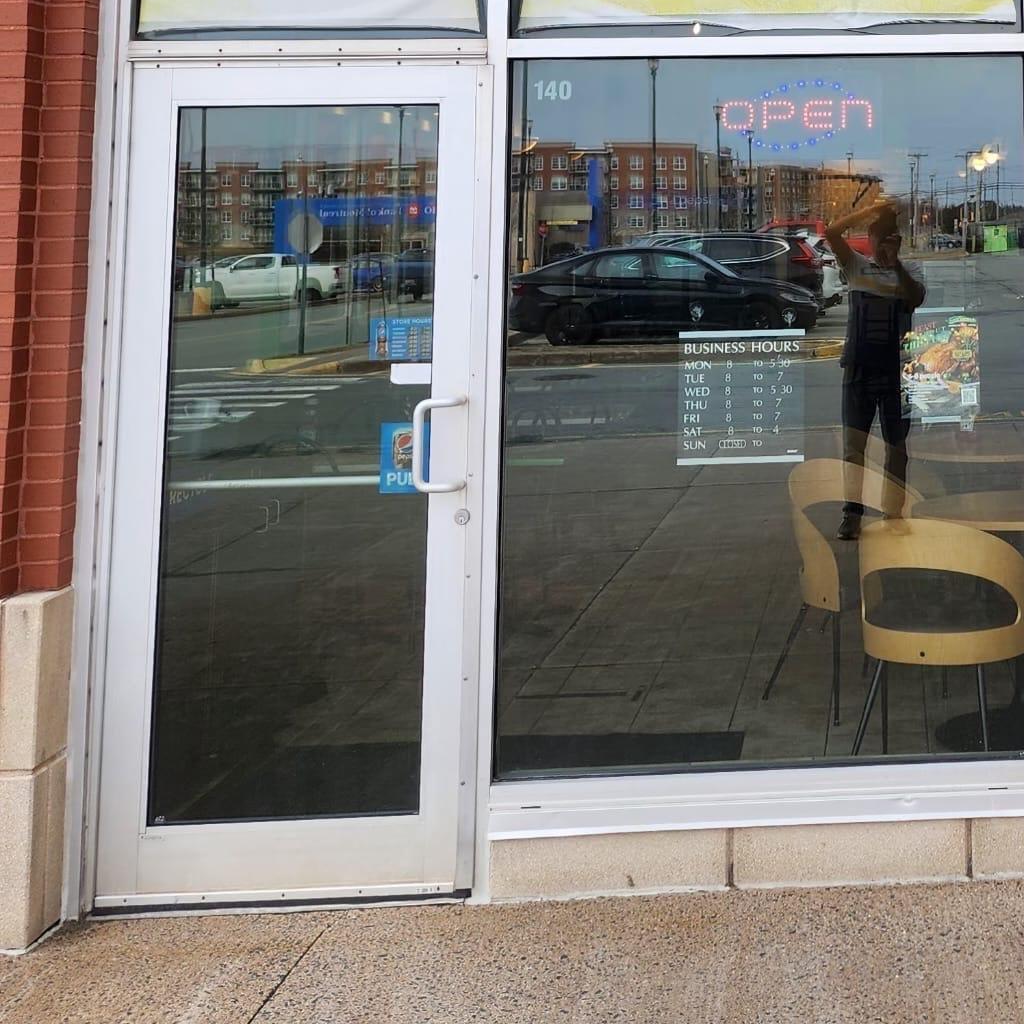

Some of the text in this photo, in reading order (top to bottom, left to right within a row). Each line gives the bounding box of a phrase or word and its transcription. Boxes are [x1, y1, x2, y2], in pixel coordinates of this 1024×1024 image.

[534, 80, 572, 101] 140
[684, 340, 800, 355] BUSINESS HOURS
[684, 360, 712, 370] MON
[726, 360, 733, 369] 8
[753, 360, 763, 368] TO
[684, 374, 705, 384] TUE
[725, 373, 731, 382] 8
[778, 371, 784, 381] 7
[684, 387, 711, 397] WED
[725, 386, 731, 396] 8
[780, 385, 793, 394] 30
[684, 400, 708, 410] THU
[725, 400, 732, 409] 8
[775, 398, 782, 408] 7
[683, 414, 700, 424] FRI
[725, 413, 732, 423] 8
[774, 411, 781, 421] 7
[683, 425, 780, 437] SAT 8 TO 4
[683, 440, 707, 450] SUN
[386, 471, 414, 487] PUL
